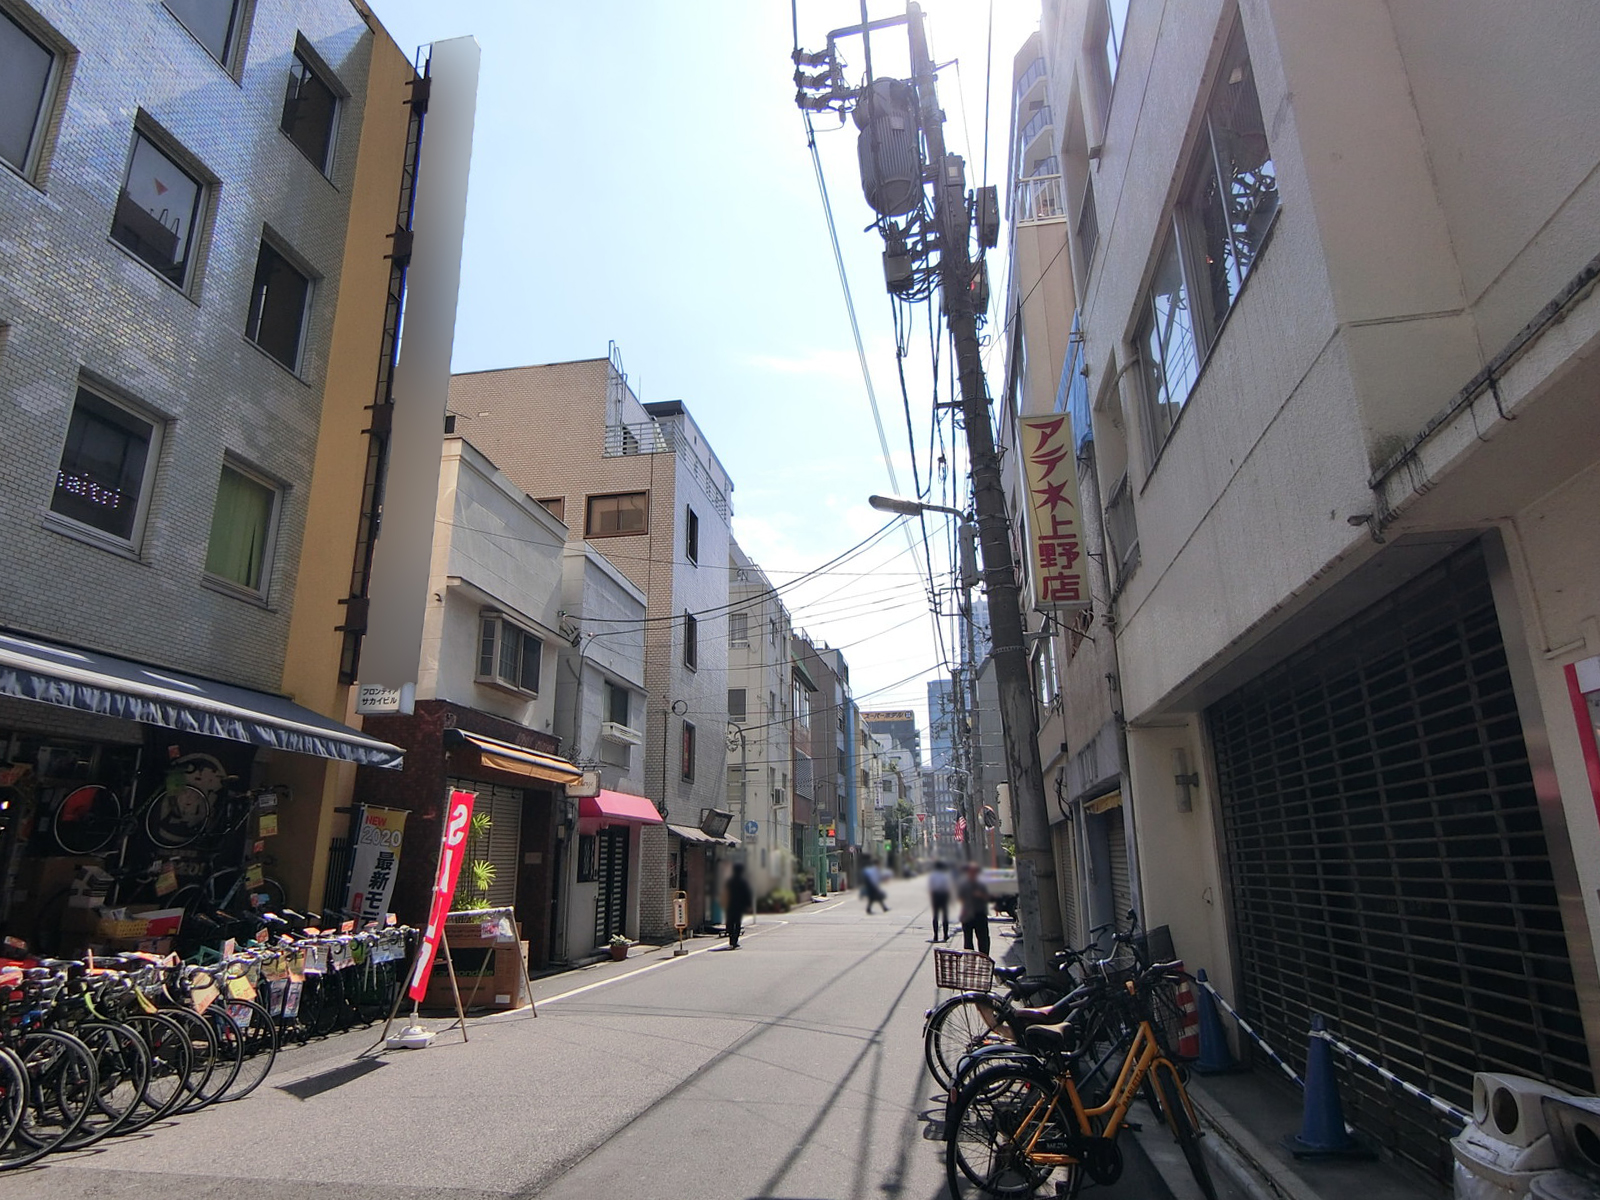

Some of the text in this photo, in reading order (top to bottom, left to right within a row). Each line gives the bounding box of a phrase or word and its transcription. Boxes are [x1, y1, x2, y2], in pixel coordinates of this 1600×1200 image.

[362, 697, 397, 706] サカイビル
[365, 815, 387, 827] NEW
[361, 825, 402, 847] 2020
